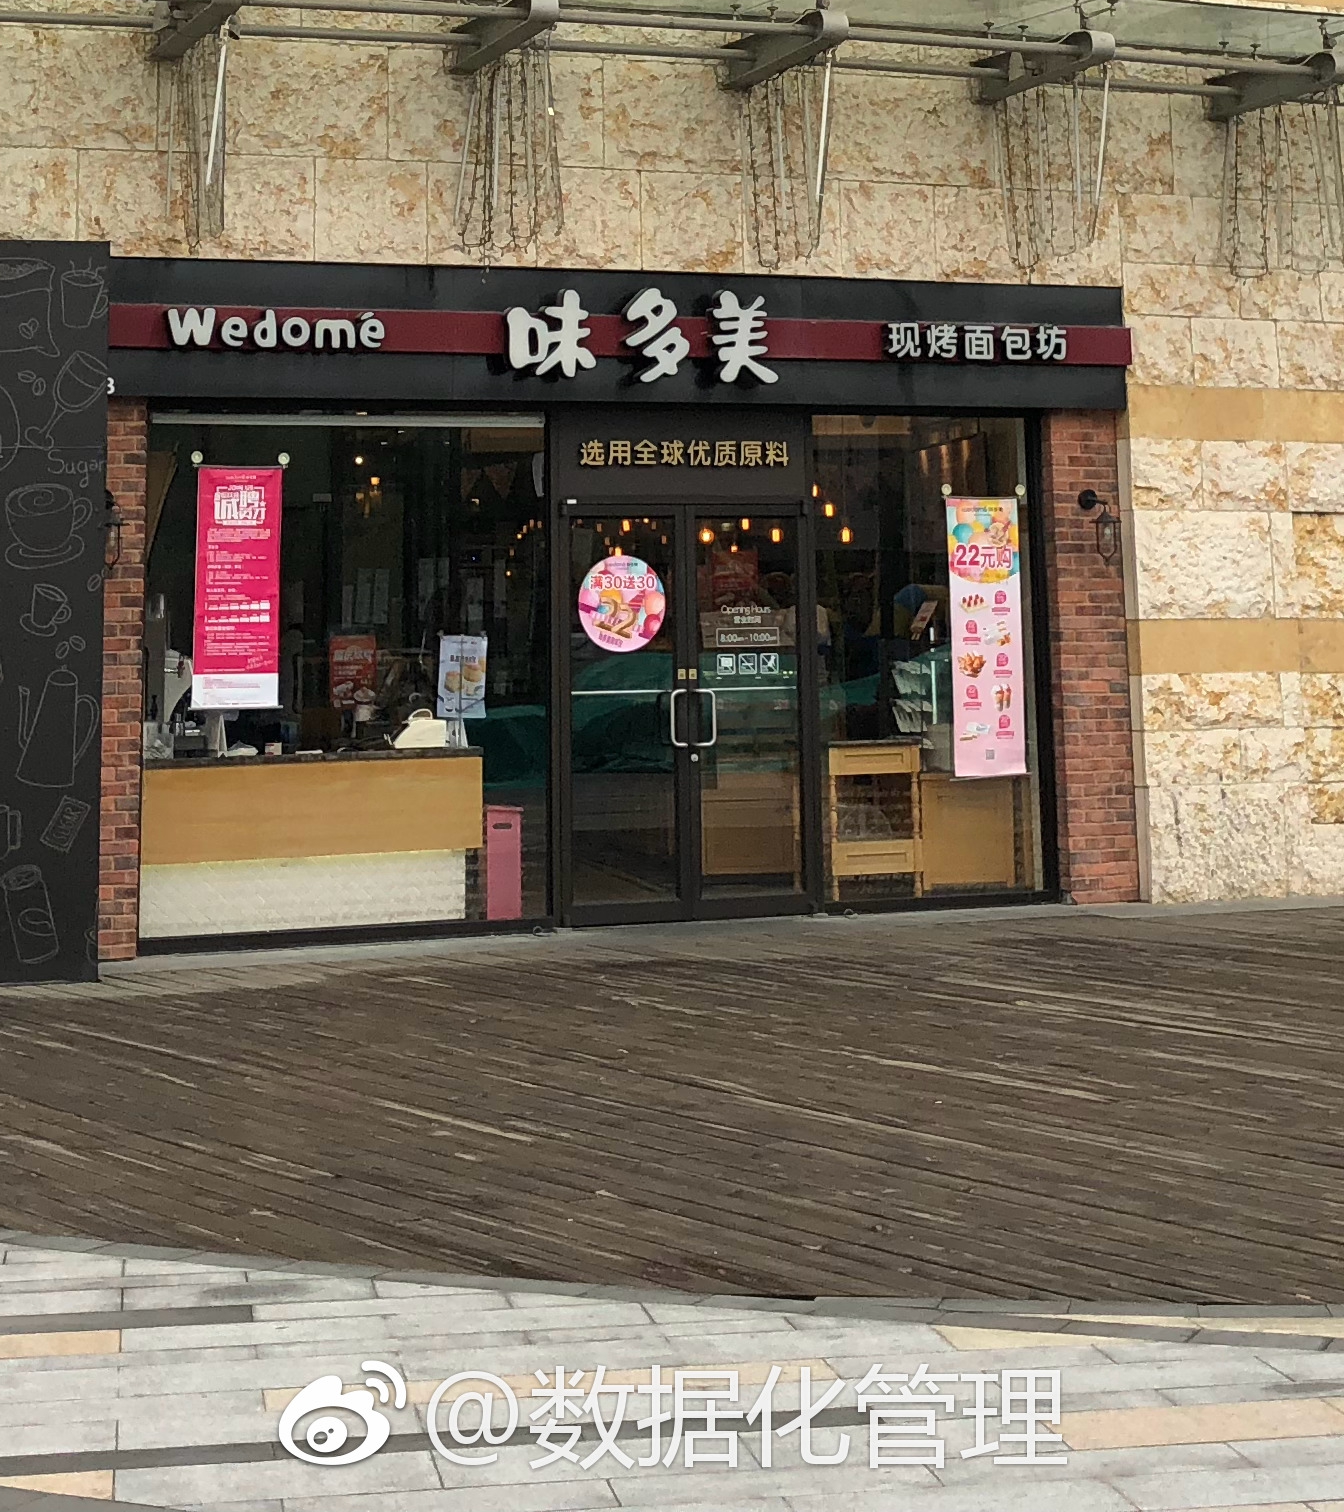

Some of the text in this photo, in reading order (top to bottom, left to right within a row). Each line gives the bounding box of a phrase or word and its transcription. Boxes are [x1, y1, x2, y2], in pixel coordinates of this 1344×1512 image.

[506, 288, 779, 383] 味多美
[888, 321, 1068, 362] 现烤面包坊
[47, 449, 106, 488] Sugar
[580, 439, 789, 469] 选用全球优质原料
[956, 544, 1012, 569] 22元购
[590, 575, 655, 590] 满30送30
